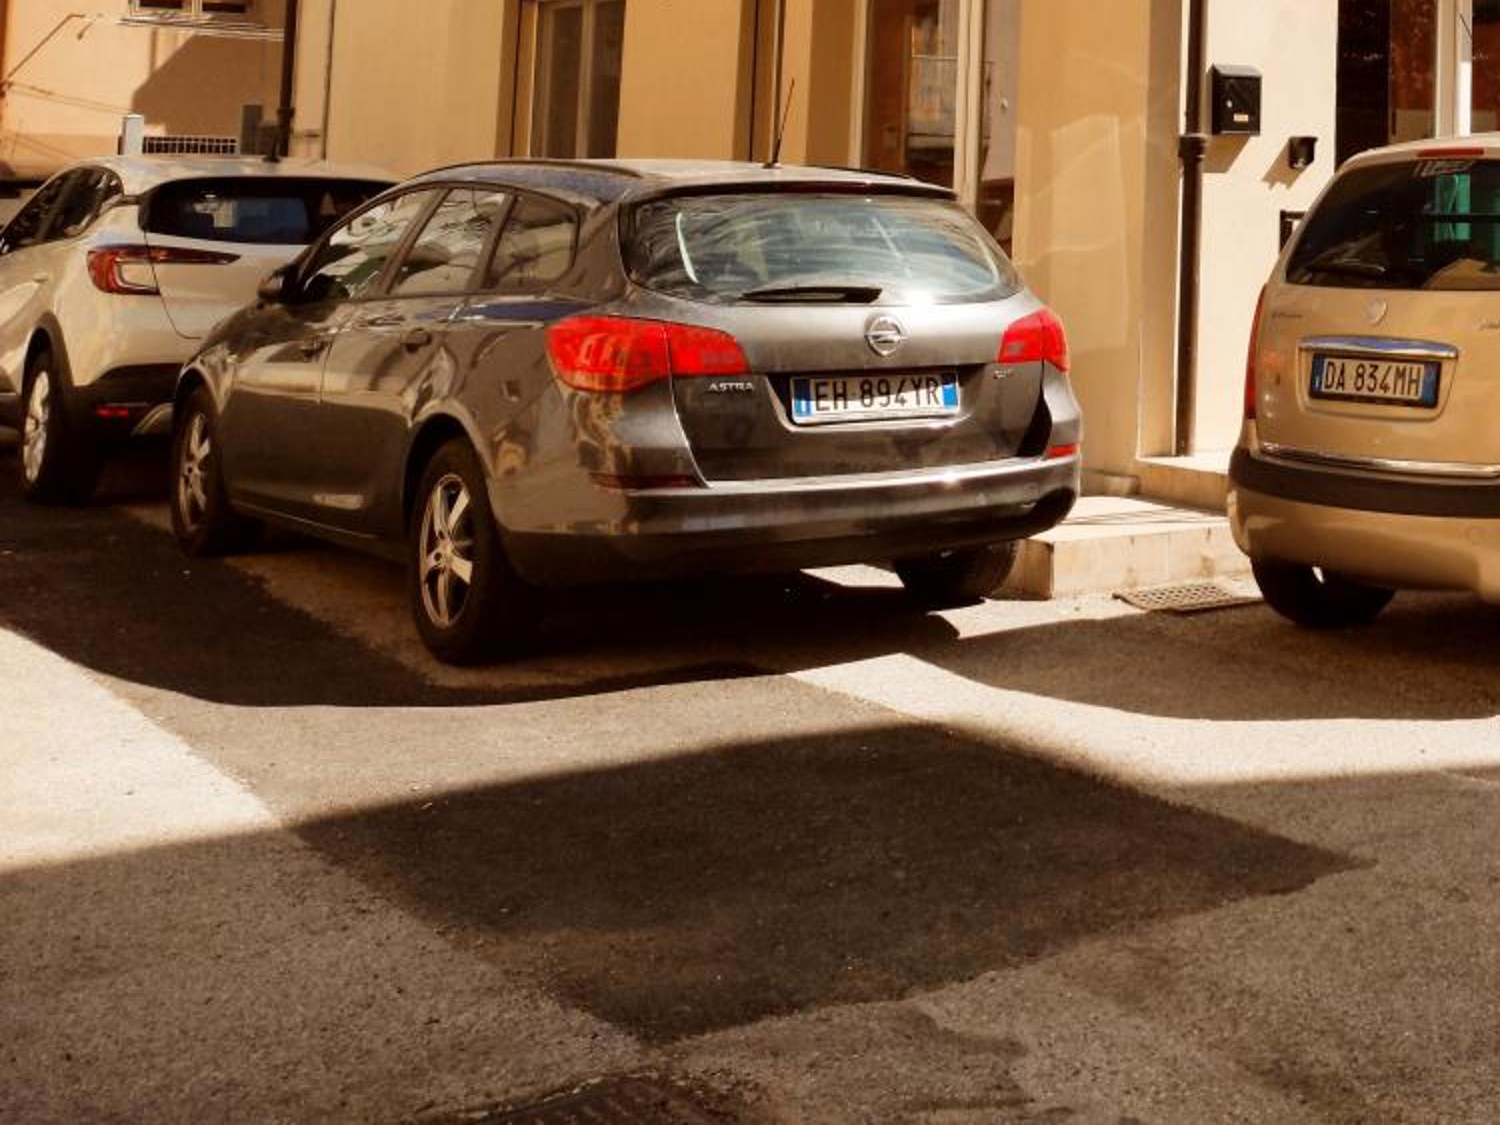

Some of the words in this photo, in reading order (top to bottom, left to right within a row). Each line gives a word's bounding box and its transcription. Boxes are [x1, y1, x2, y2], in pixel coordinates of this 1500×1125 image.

[707, 381, 754, 393] ASTRA
[1325, 361, 1345, 391] DA
[1353, 363, 1421, 396] 834MH
[814, 379, 848, 412] EH
